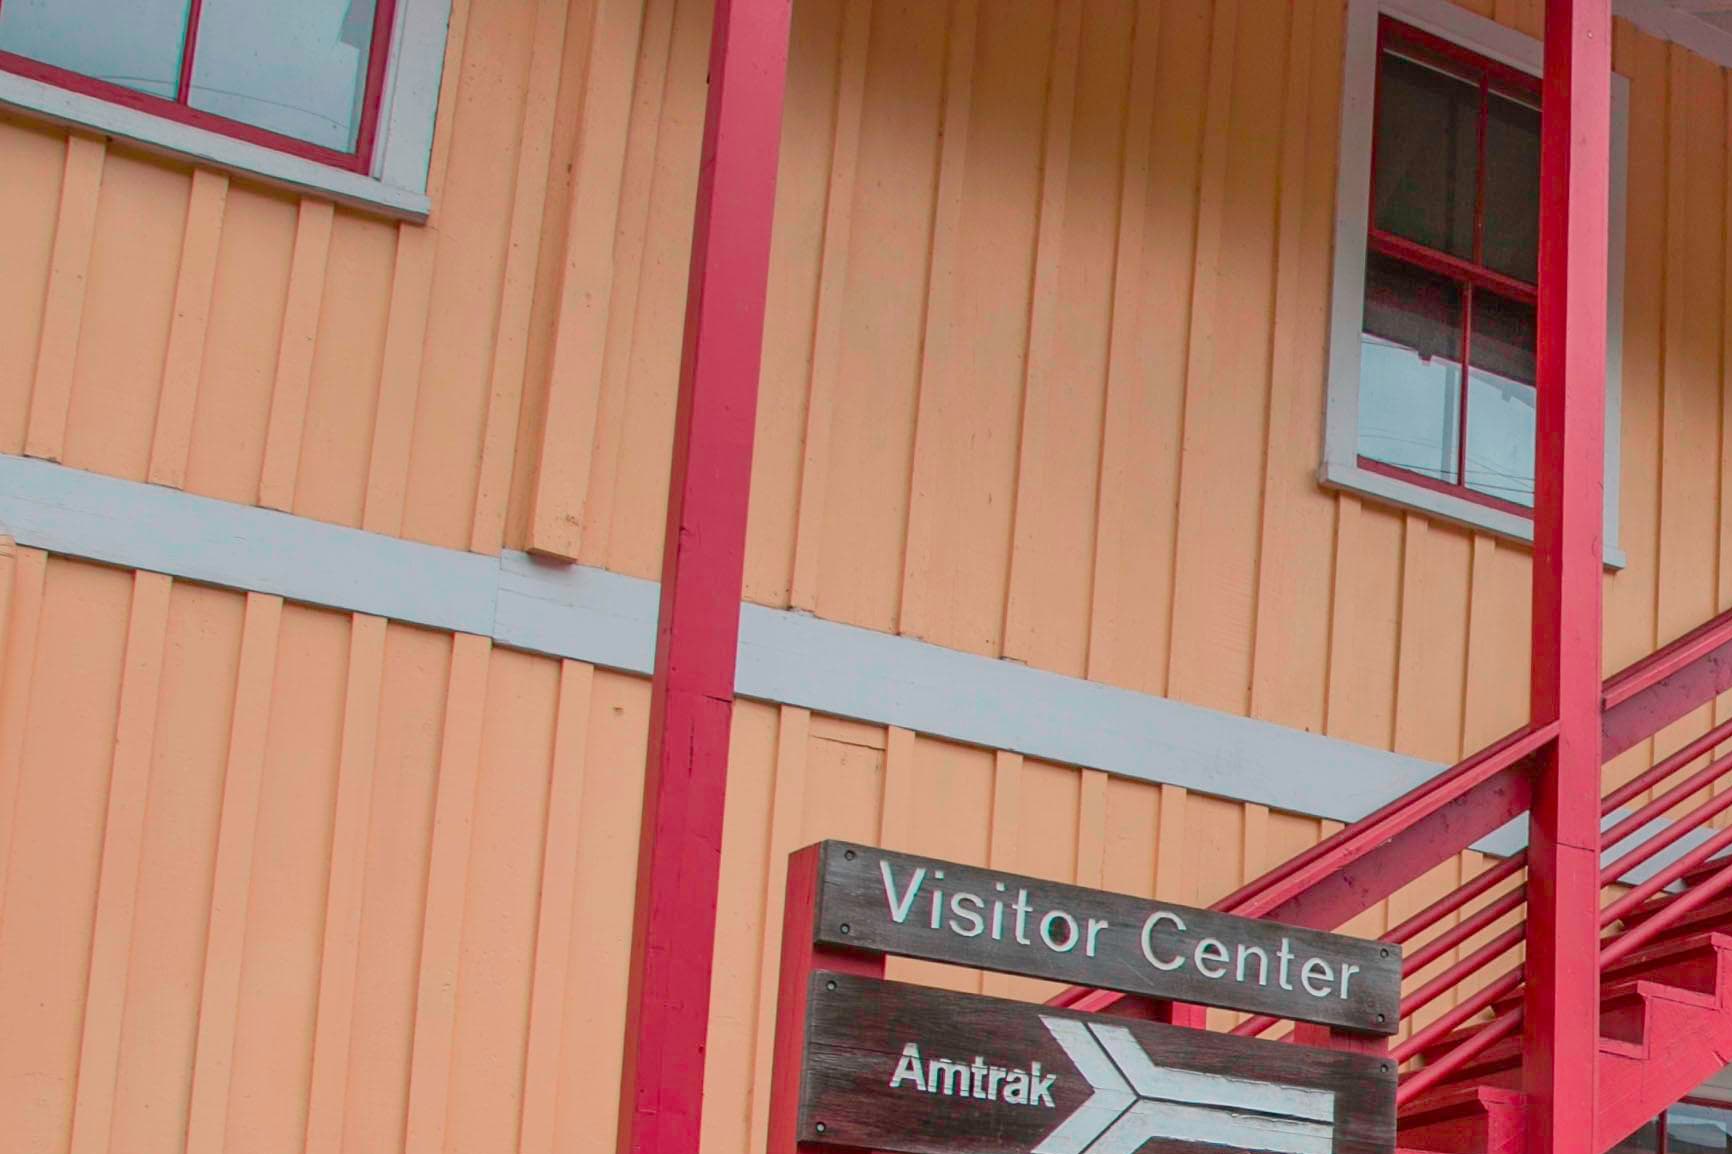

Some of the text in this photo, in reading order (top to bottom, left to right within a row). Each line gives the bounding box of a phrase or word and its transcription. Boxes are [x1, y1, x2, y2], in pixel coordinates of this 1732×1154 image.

[880, 860, 1361, 1000] Visitor Center
[890, 1042, 1056, 1108] Amtrak
